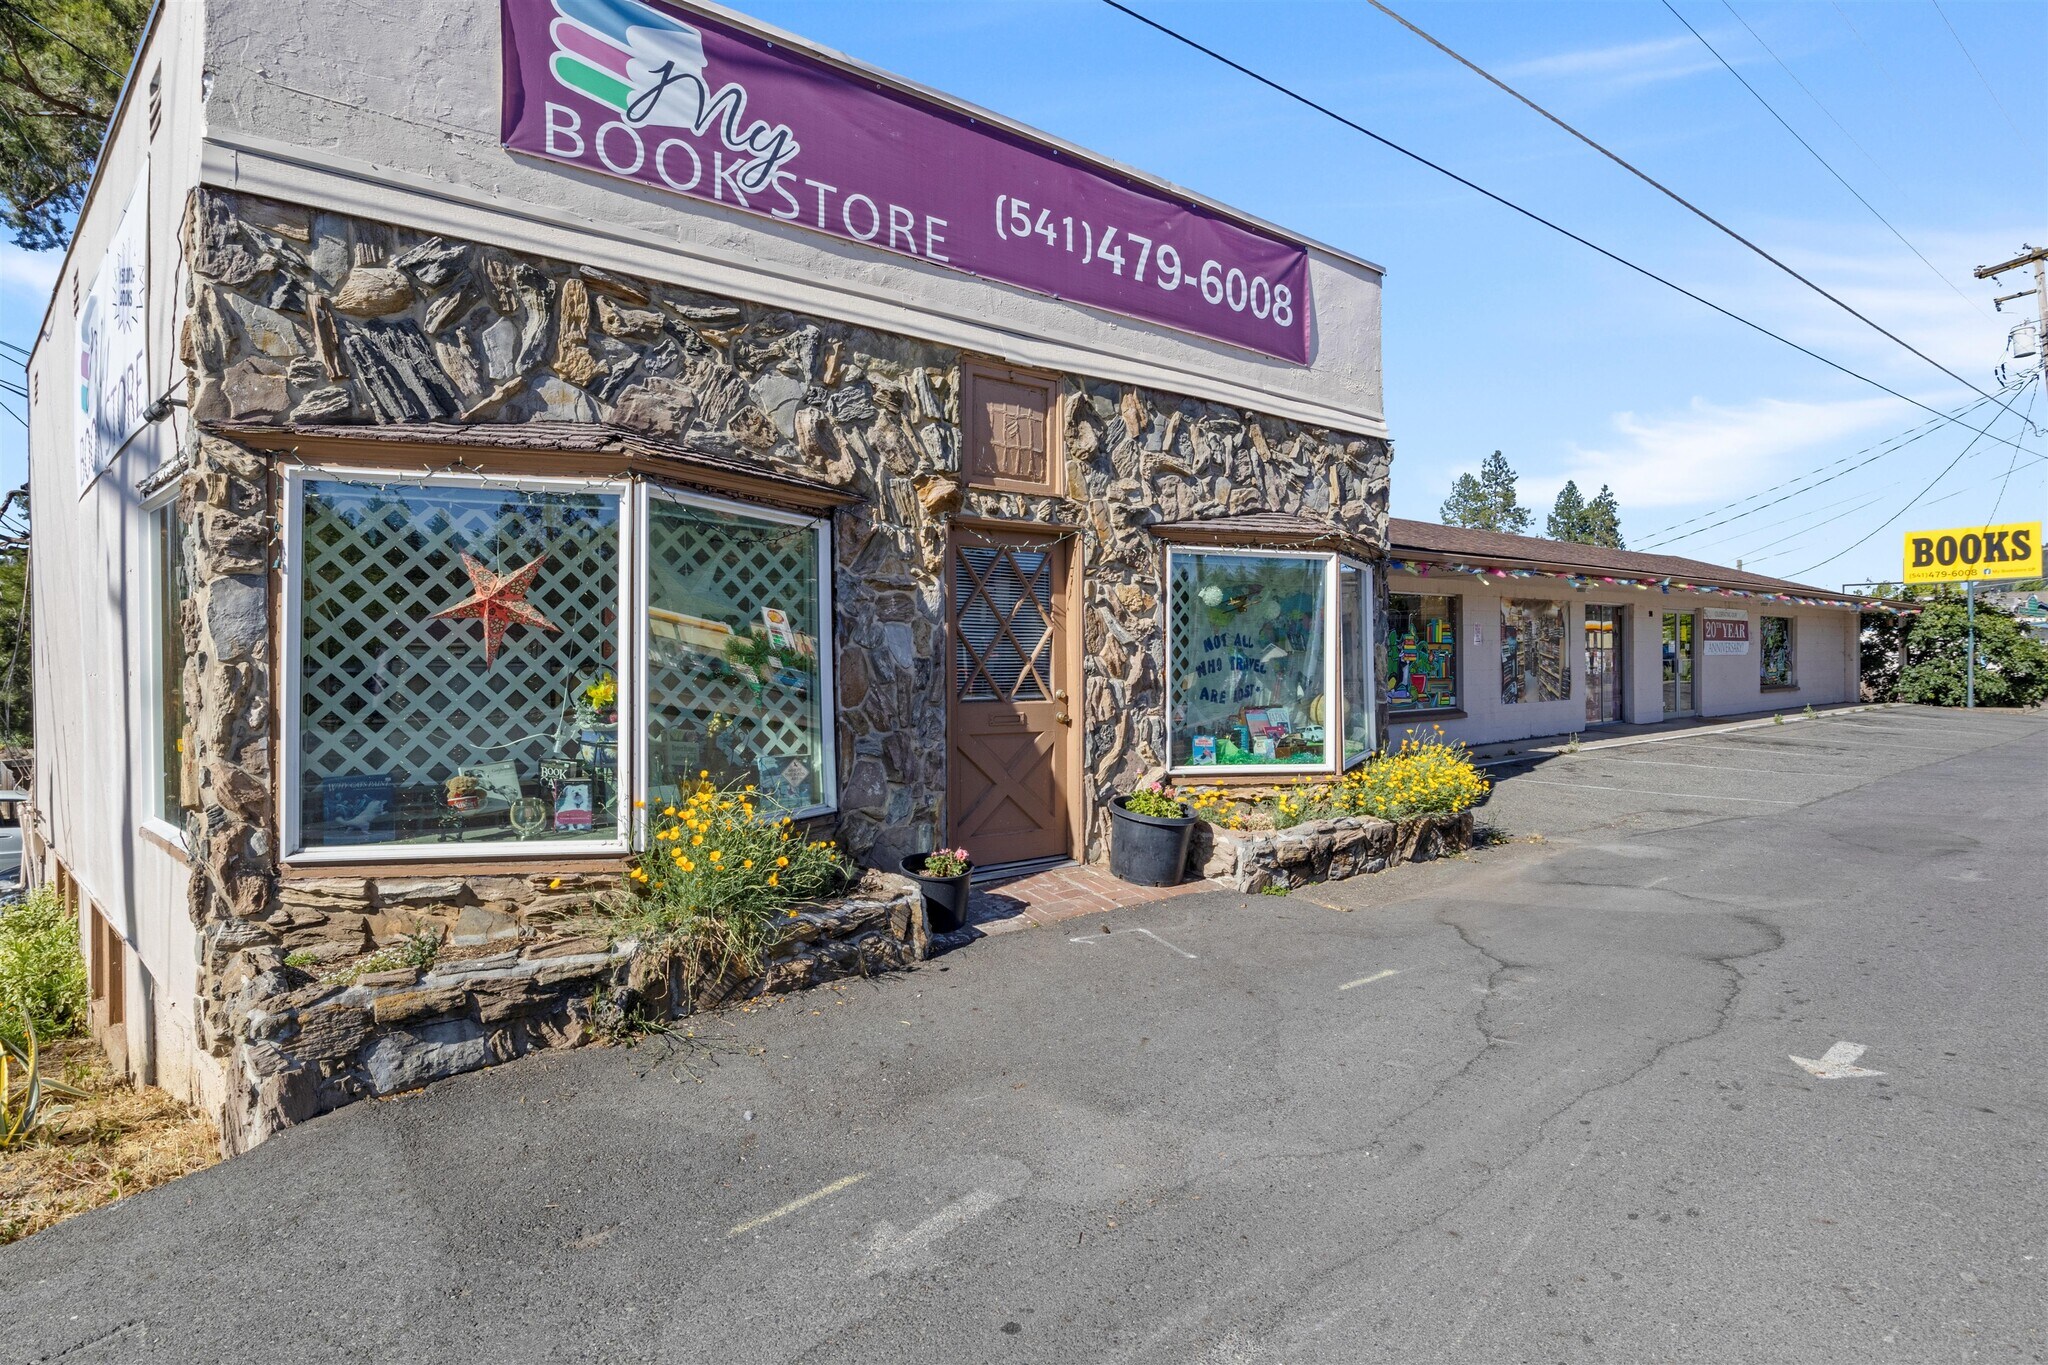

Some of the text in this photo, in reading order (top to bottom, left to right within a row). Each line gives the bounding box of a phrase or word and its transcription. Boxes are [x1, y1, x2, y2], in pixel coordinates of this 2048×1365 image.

[625, 60, 798, 190] My
[543, 100, 950, 264] BOOKSTORE
[1912, 530, 2032, 567] BOOKS
[1722, 623, 1745, 638] YEAR
[1204, 632, 1253, 652] NOT ALL
[1196, 656, 1267, 678] WHO TRAVEL
[1200, 687, 1226, 704] ARE
[541, 766, 567, 780] BOOK
